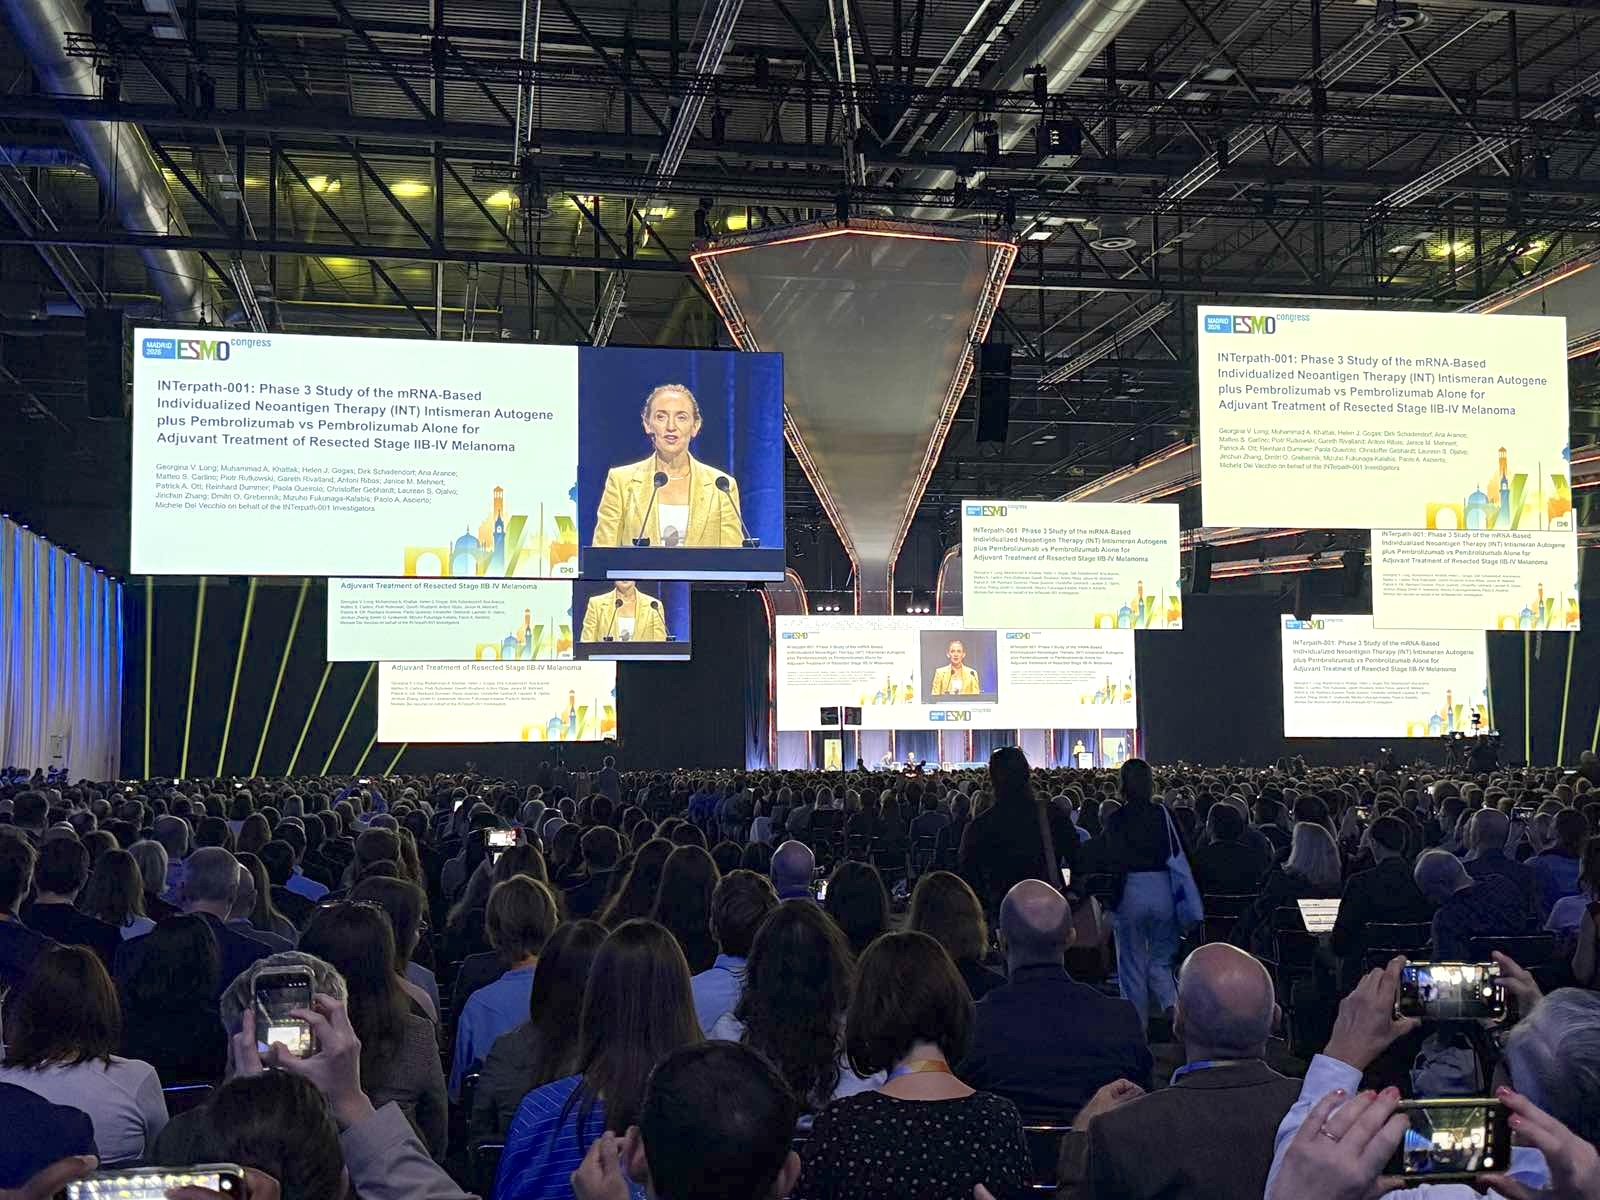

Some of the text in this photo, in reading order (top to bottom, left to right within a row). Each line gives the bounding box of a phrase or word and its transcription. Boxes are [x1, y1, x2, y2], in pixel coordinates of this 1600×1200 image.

[1233, 315, 1275, 334] ESMO
[177, 338, 272, 360] ESMO congress
[1217, 352, 1486, 368] INTerpath-001: Phase 3 Study of the mRNA-Based
[1218, 368, 1547, 387] Individualized Neoantigen Therapy (INT) Intismeran Autogene
[157, 379, 481, 401] INTerpath-001: Phase 3 Study of the mRNA-Based
[1218, 383, 1485, 399] plus Pembrolizumab vs Pembrolizumab Alone for
[157, 397, 553, 422] Individualized Neoantigen Therapy (INT) Intismeran Autogene
[1218, 399, 1516, 415] Adjuvant Treatment of Resected Stage IIB-IV Melanoma
[157, 415, 480, 434] plus Pembrolizumab vs Pembrolizumab Alone for
[156, 432, 515, 452] Adjuvant Treatment of Resected Stage IIB-IV Melanoma
[982, 506, 1007, 516] ESMO
[946, 711, 971, 721] ESMO
